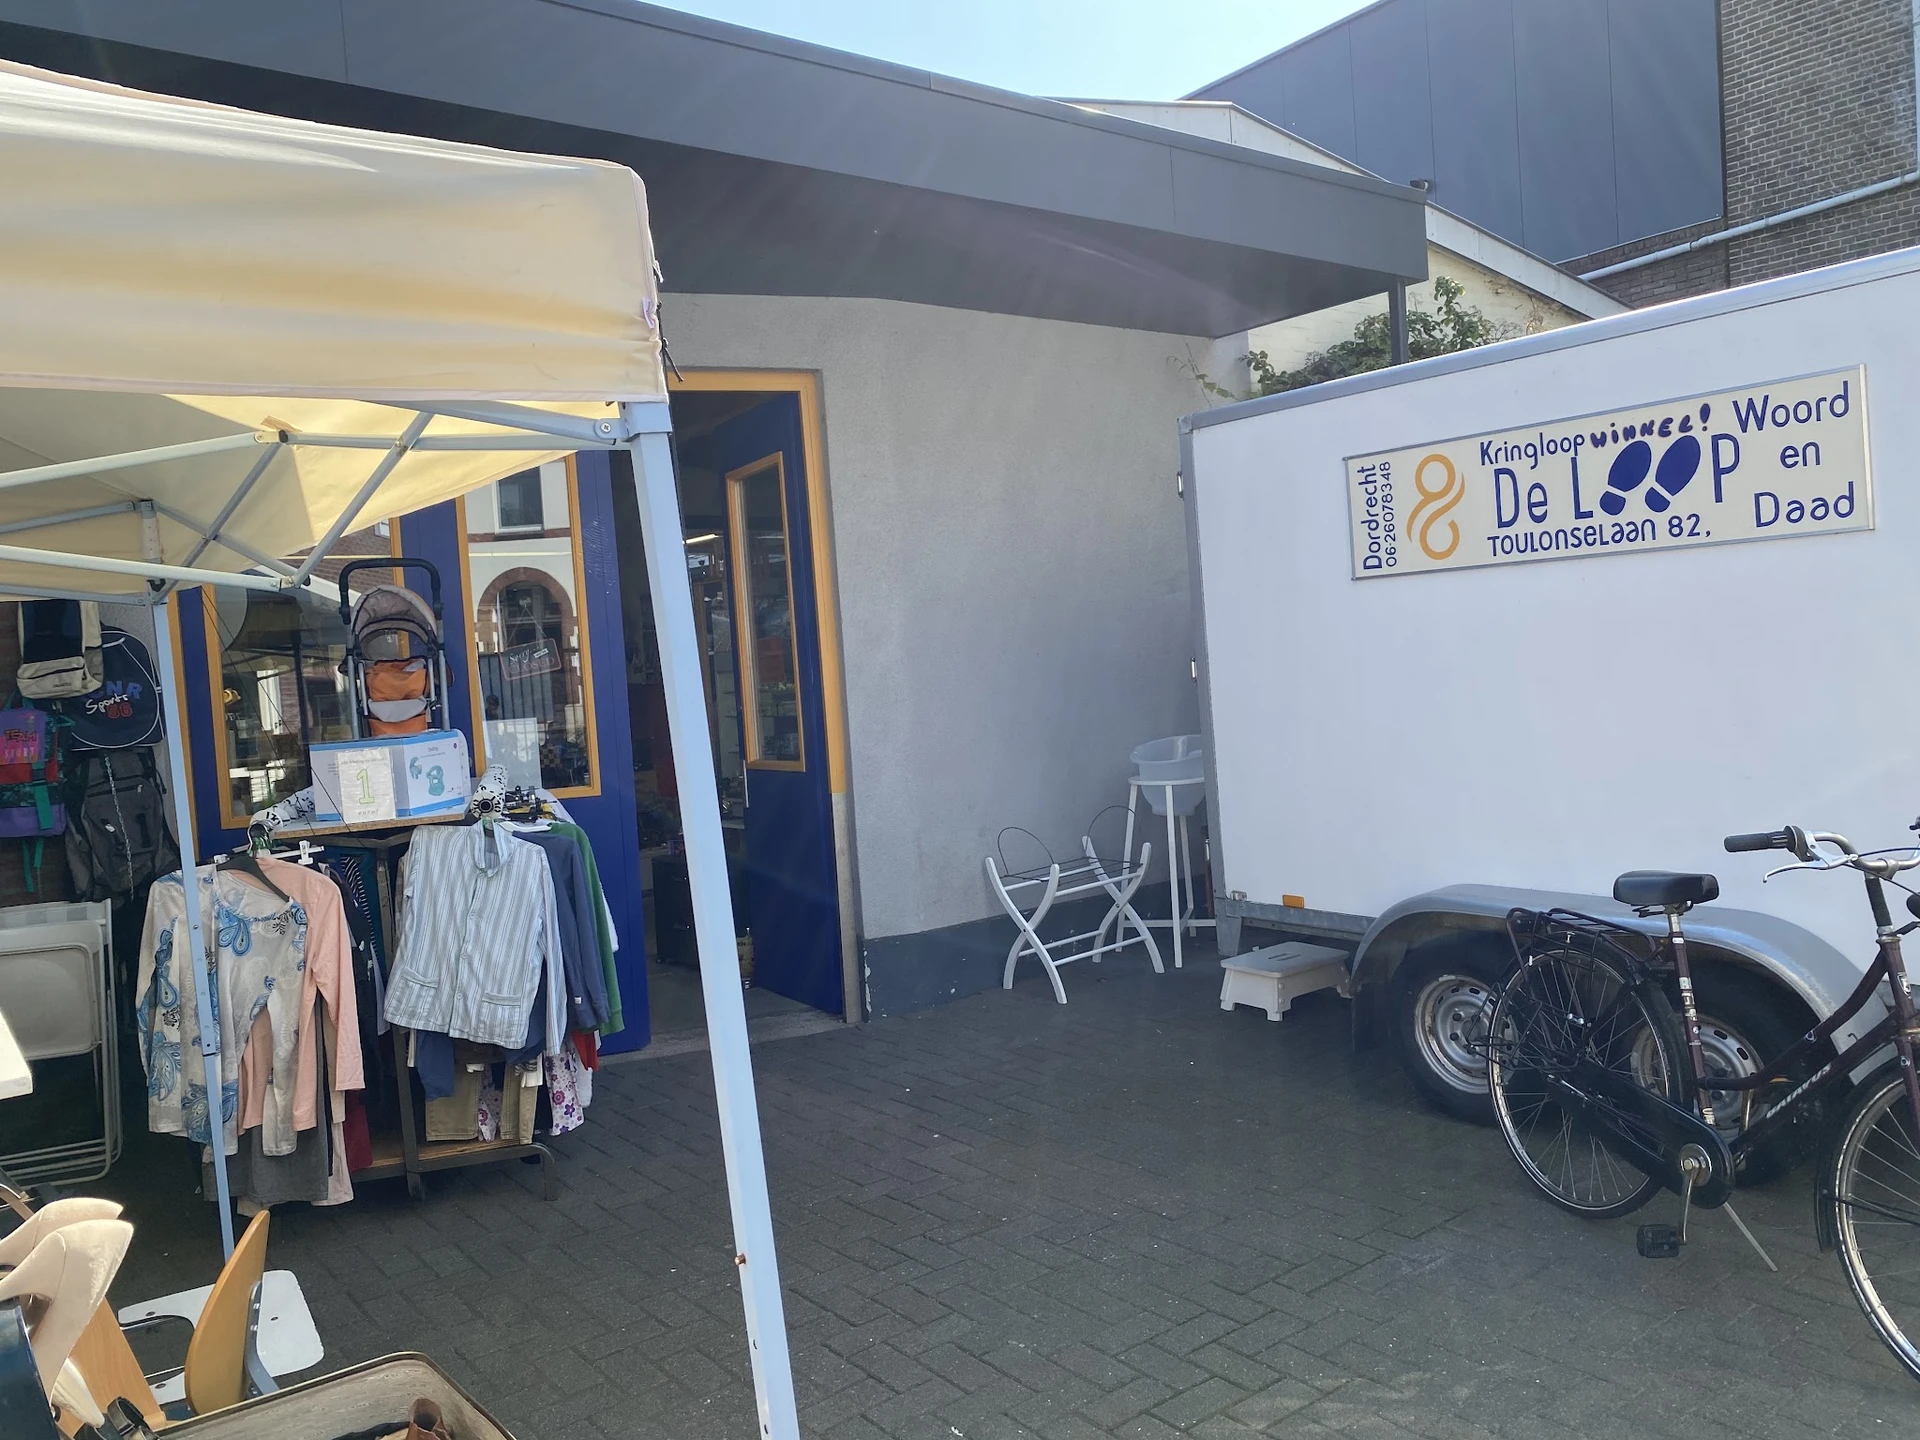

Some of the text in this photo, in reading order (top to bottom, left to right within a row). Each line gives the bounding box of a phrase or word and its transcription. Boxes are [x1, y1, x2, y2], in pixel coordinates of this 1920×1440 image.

[1731, 381, 1850, 434] Woord
[1479, 431, 1585, 471] Kringloop
[1779, 441, 1821, 469] en
[1356, 464, 1383, 571] Dordrecht
[1378, 461, 1398, 568] 06-26078348
[1493, 468, 1549, 530] De
[1753, 480, 1856, 529] Daad
[1667, 512, 1711, 538] 82,
[85, 693, 129, 715] Sports
[4, 728, 38, 743] TEAM
[356, 768, 375, 804] 1
